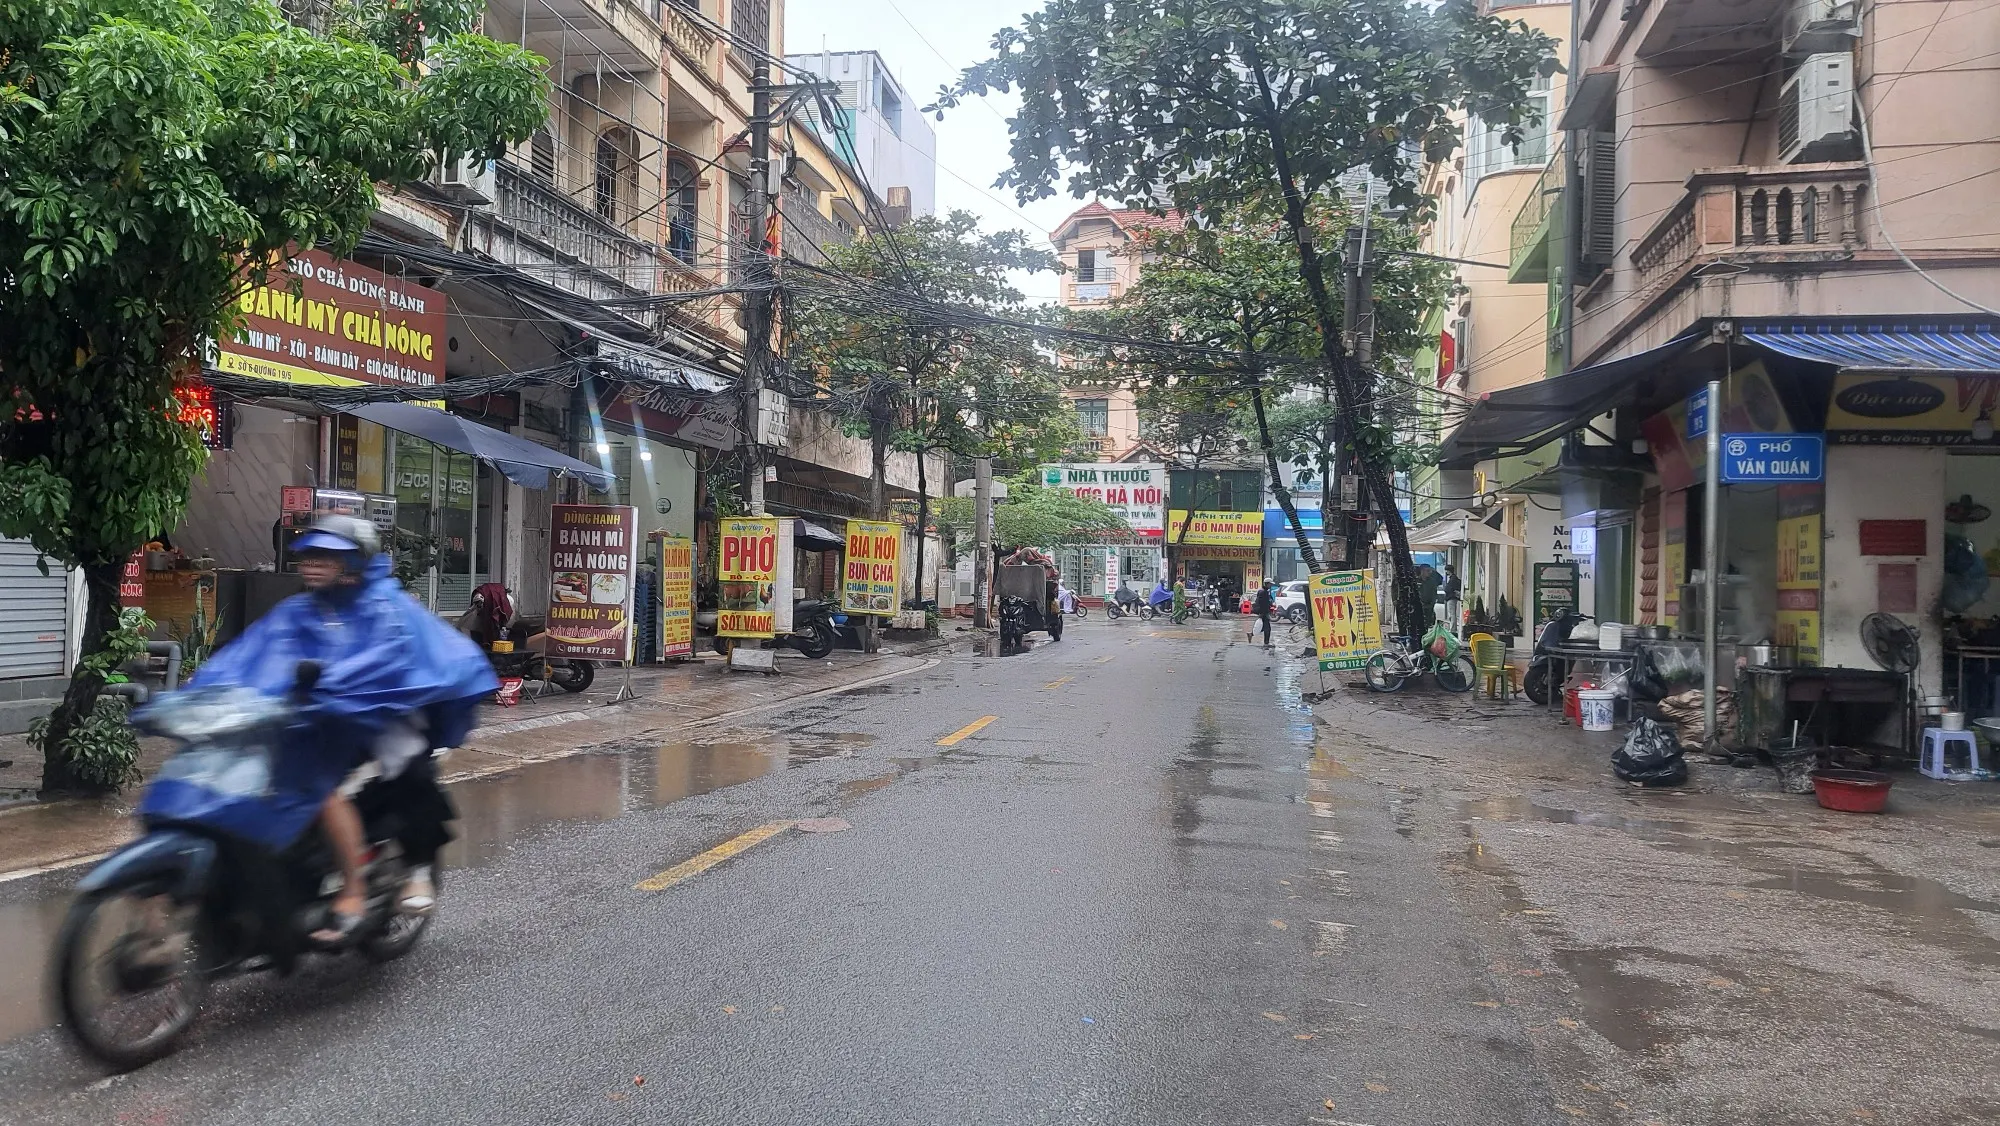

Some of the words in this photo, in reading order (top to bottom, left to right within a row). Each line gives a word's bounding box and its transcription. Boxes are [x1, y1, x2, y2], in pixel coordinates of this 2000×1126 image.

[317, 267, 346, 289] CHẢ
[349, 276, 387, 300] DŨNG
[389, 292, 425, 315] HẠNH
[342, 310, 383, 348] CHẢ
[384, 318, 434, 362] NÓNG
[289, 339, 306, 359] XÔI
[314, 345, 340, 367] BÁNH
[382, 361, 400, 380] CHẢ
[400, 366, 417, 385] CÁC
[1759, 439, 1792, 453] PHỐ
[1067, 467, 1098, 483] NHÀ
[1102, 464, 1151, 483] THUỐC
[1736, 457, 1765, 475] VĂN
[1771, 456, 1810, 475] QUÁN
[1106, 485, 1129, 505] HÀ
[1133, 485, 1163, 511] NỘI
[564, 511, 593, 525] DŨNG
[593, 514, 621, 528] HẠNH
[1195, 520, 1207, 533] BÒ
[1211, 523, 1234, 534] NAM
[1237, 524, 1261, 536] ĐỊNH
[559, 526, 601, 547] BÁNH
[605, 528, 624, 547] MÌ
[850, 534, 870, 559] BIA
[874, 534, 896, 561] HƠI
[553, 548, 583, 569] CHẢ
[587, 551, 628, 571] NÓNG
[723, 526, 776, 573] PHỞ
[848, 560, 870, 581] BÚN
[873, 561, 894, 583] CHẢ
[873, 584, 894, 594] CHAN
[551, 605, 578, 620] BÁNH
[608, 607, 625, 621] XÔI
[721, 611, 742, 631] SỐT
[744, 614, 772, 633] VANG
